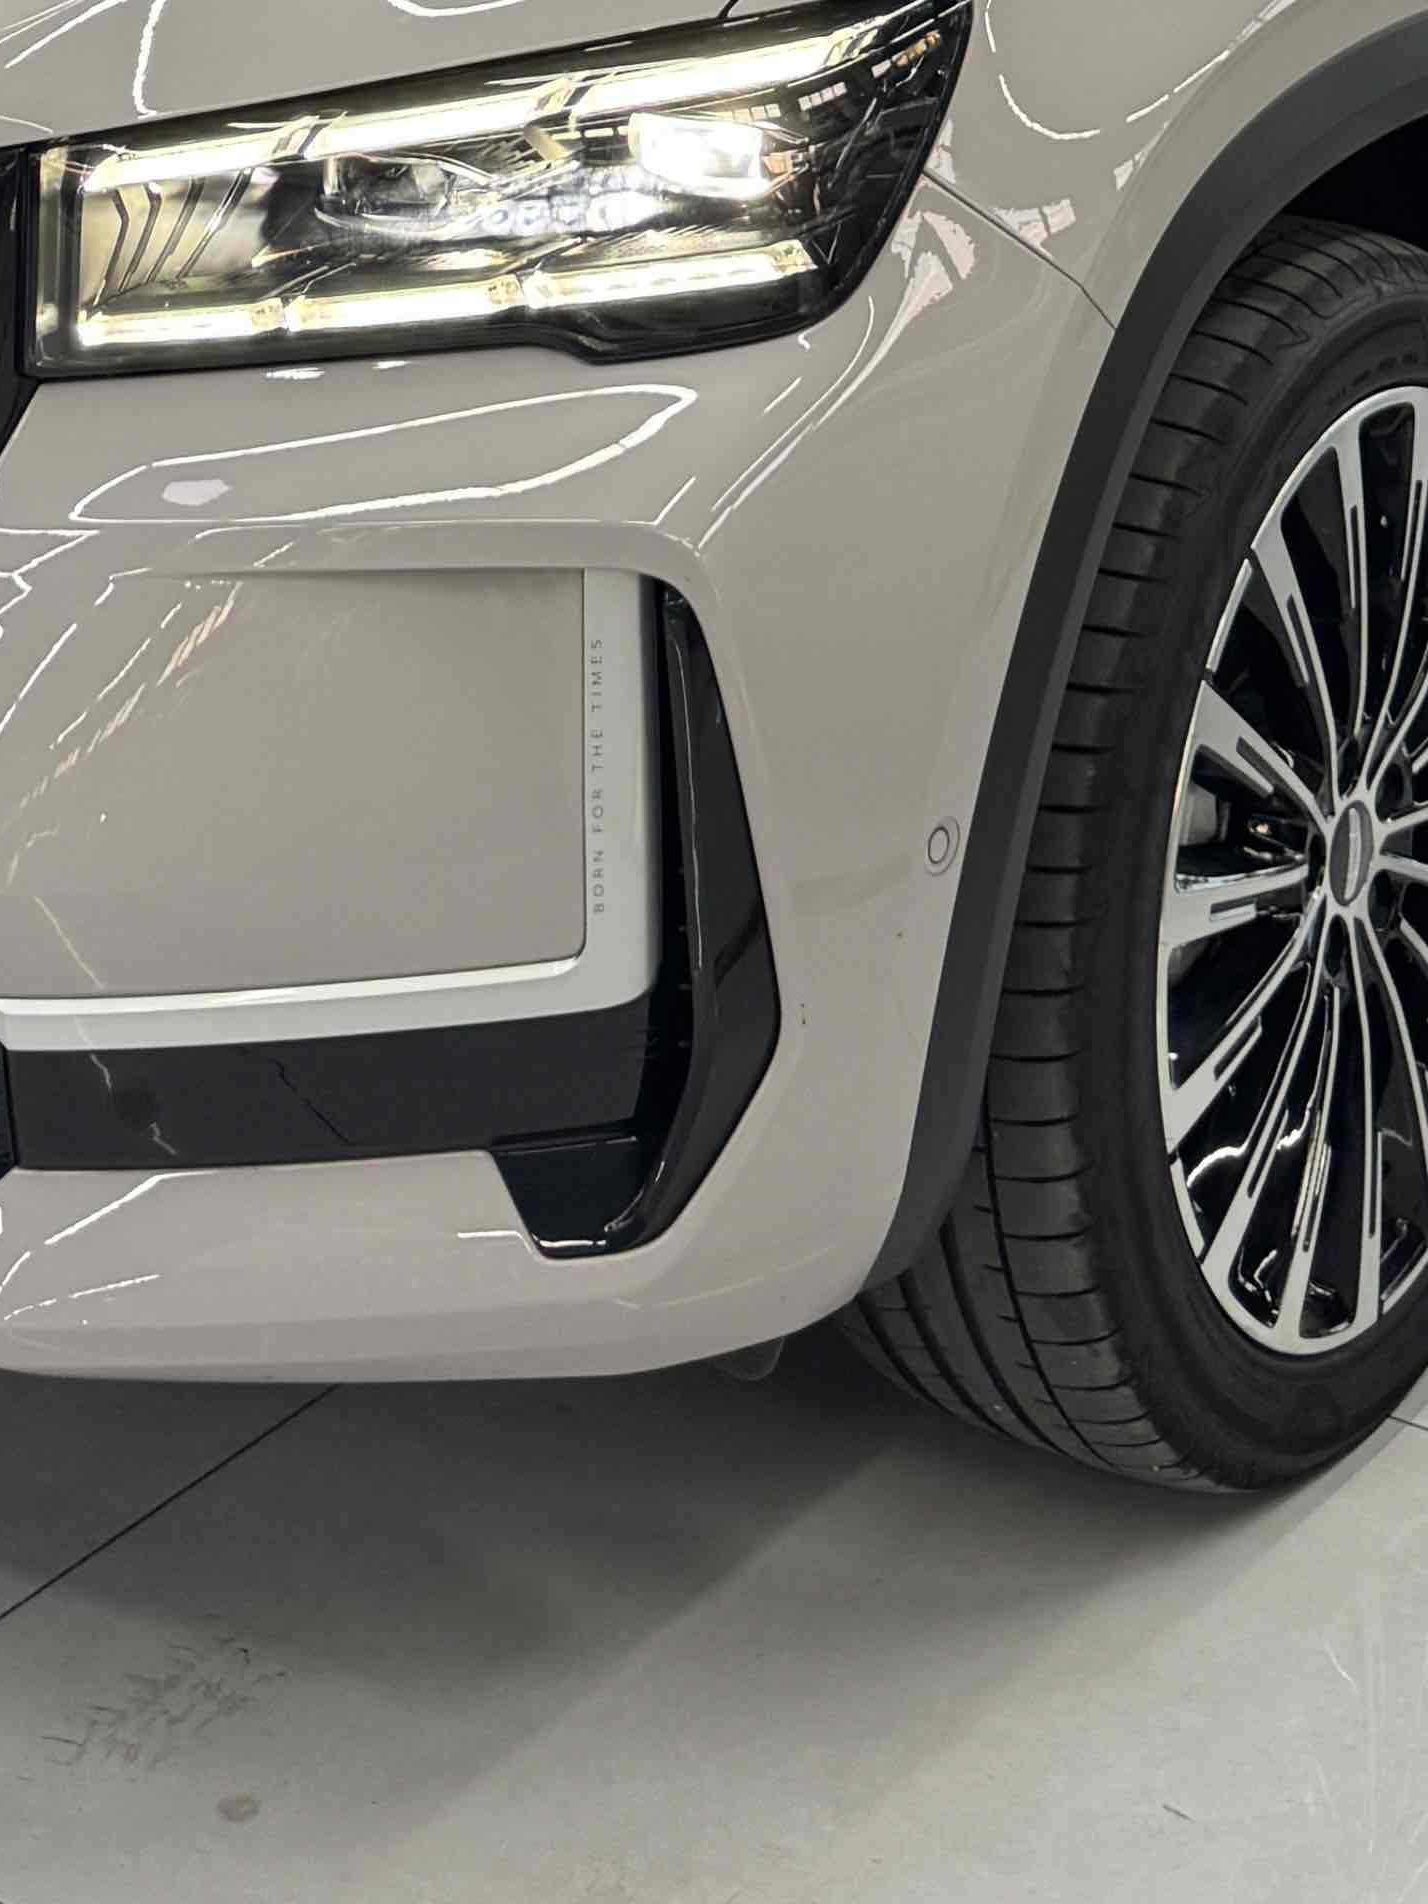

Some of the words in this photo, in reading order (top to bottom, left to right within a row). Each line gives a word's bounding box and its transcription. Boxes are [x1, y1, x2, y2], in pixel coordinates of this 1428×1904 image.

[590, 638, 604, 714] TIMES
[590, 728, 604, 774] THE
[591, 788, 605, 834] FOR
[592, 849, 606, 915] BORN
